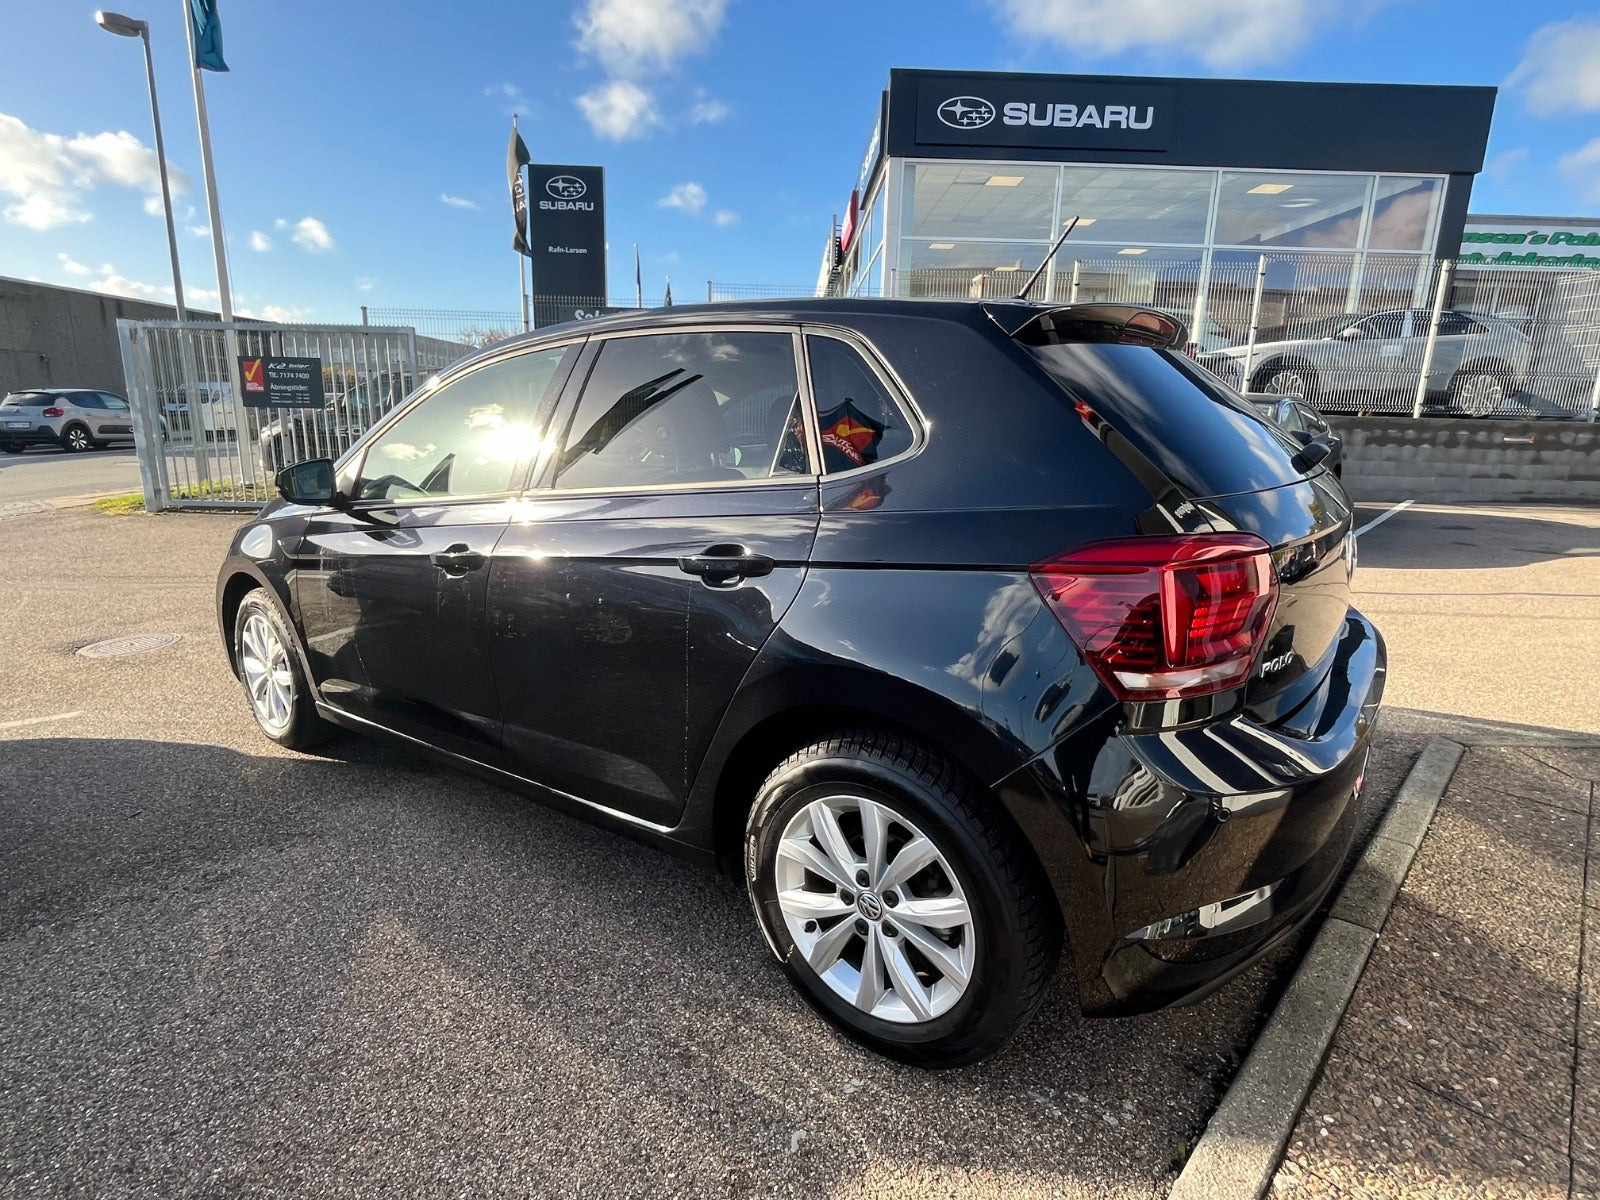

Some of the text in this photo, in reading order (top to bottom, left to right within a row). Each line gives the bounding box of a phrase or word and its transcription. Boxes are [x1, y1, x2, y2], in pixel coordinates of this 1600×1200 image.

[1003, 102, 1154, 129] SUBARU
[539, 200, 594, 211] SUBARU
[548, 246, 588, 254] Rafn-Larsen
[268, 362, 287, 370] K2
[1260, 651, 1293, 678] POLO
